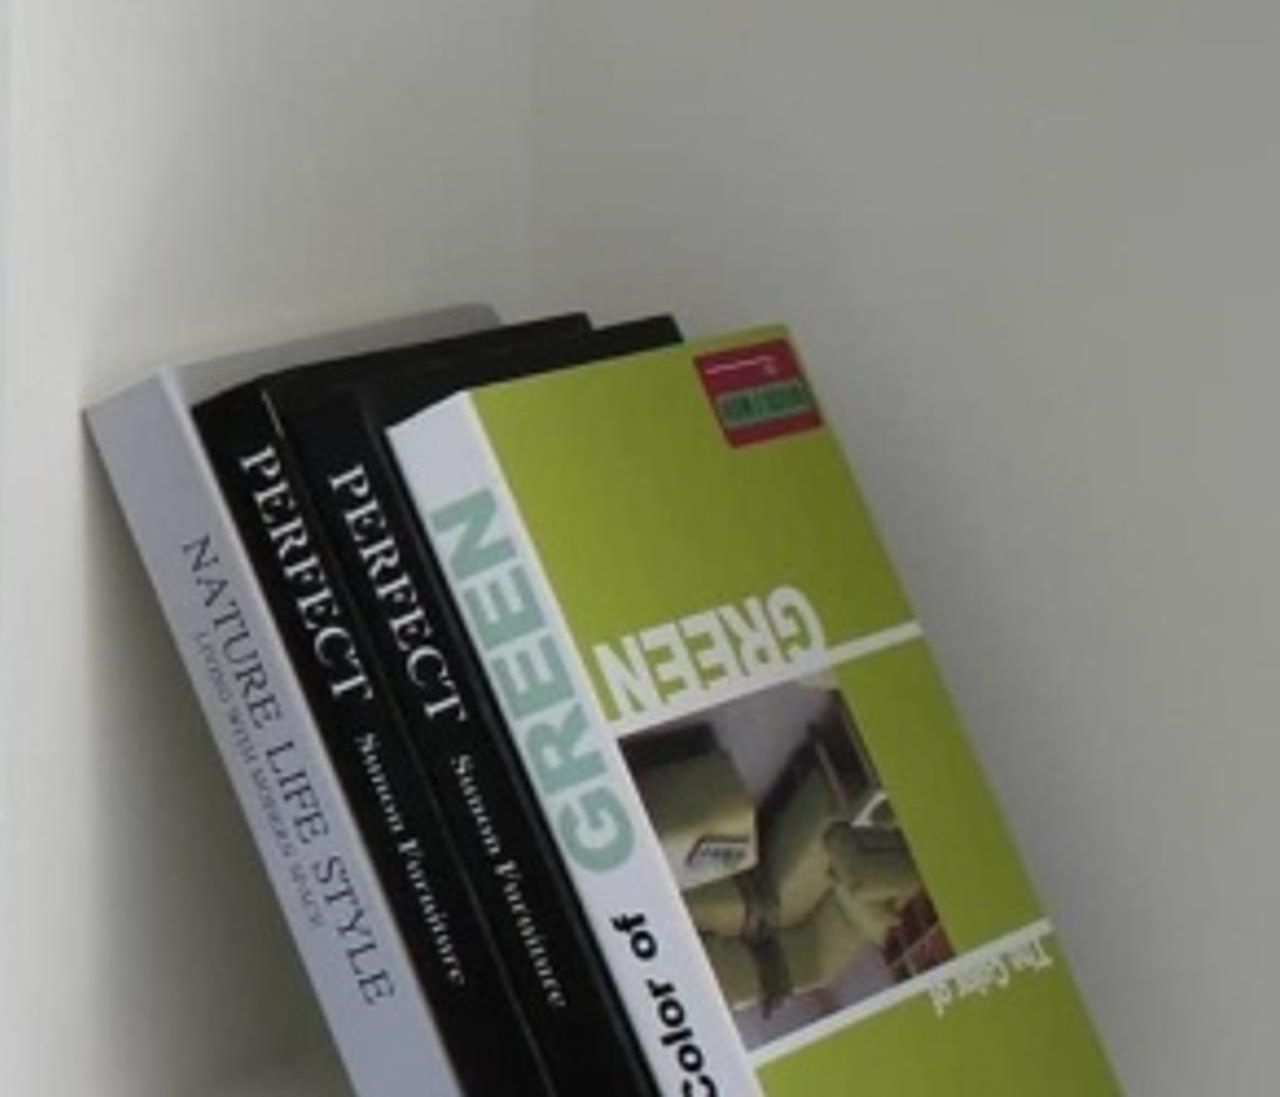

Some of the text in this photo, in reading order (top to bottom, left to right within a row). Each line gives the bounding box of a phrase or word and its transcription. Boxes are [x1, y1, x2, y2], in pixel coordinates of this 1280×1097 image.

[240, 446, 376, 701] PERFECT
[329, 463, 471, 726] PERFECT
[428, 486, 636, 876] GREEN
[593, 585, 827, 722] GREEN
[182, 535, 396, 1007] NATURE LIFE STYLE
[612, 911, 658, 961] of
